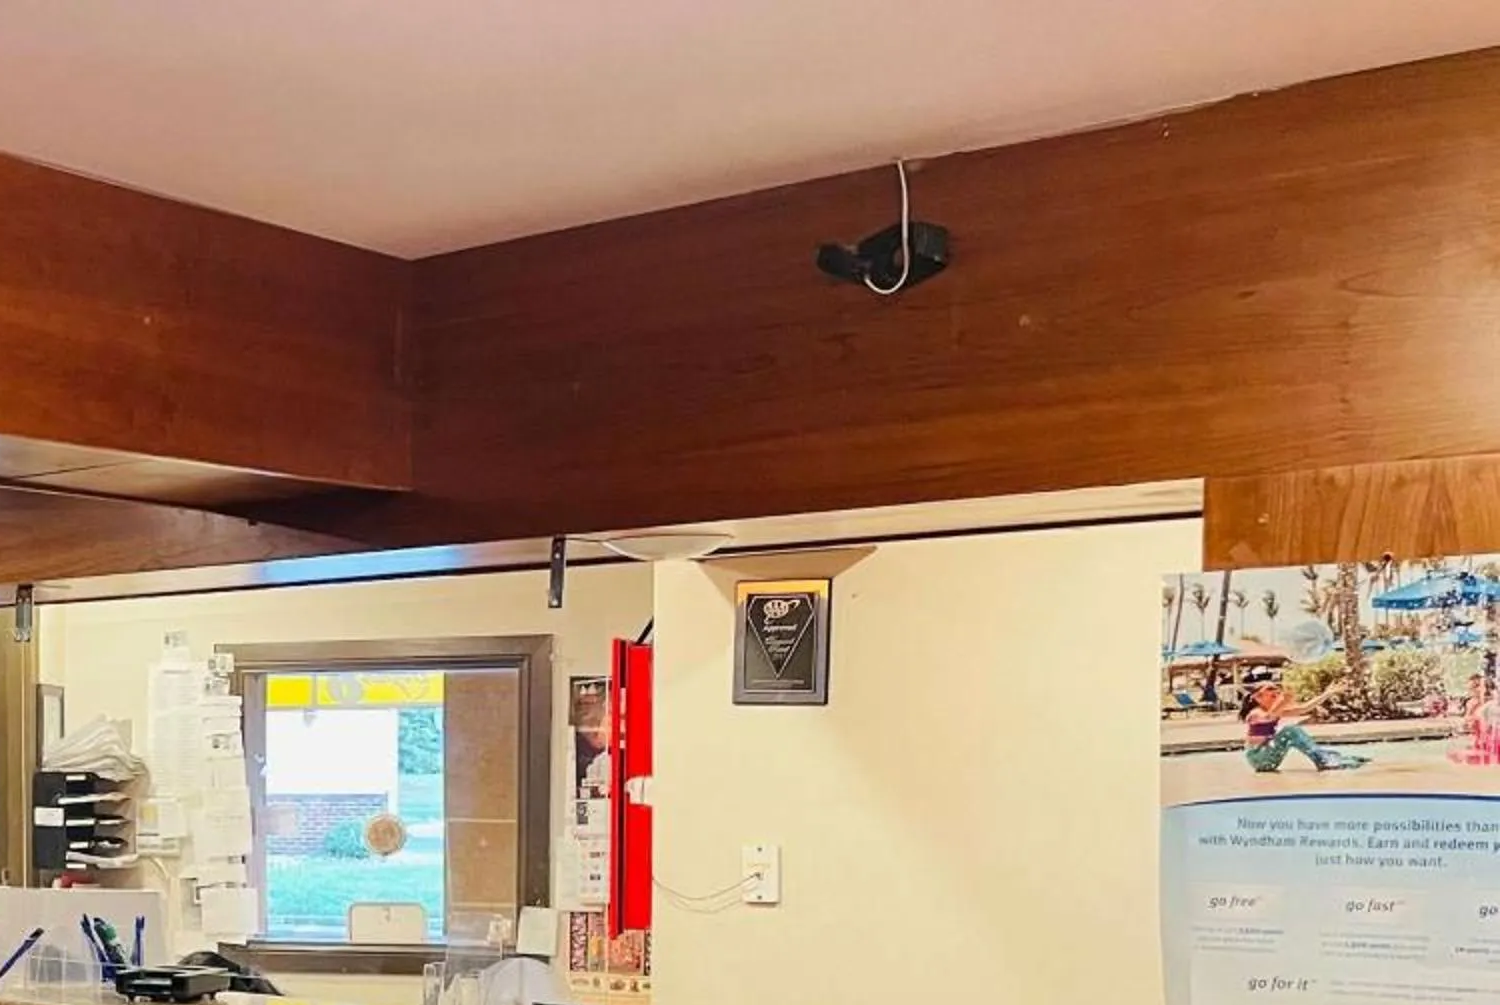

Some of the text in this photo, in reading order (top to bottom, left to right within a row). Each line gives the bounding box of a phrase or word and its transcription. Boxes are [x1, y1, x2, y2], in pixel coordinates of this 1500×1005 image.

[1237, 817, 1500, 833] Now you have more possibilities than
[1198, 834, 1227, 846] with
[1229, 834, 1296, 848] Wyndham
[1367, 836, 1399, 849] Earn
[1403, 838, 1430, 850] and
[1433, 838, 1489, 851] redeem
[1314, 853, 1342, 867] just
[1345, 853, 1375, 866] how
[1379, 856, 1404, 868] you
[1208, 897, 1227, 909] go
[1345, 901, 1365, 913] go
[1479, 905, 1499, 917] go
[1248, 976, 1310, 992] go for it
